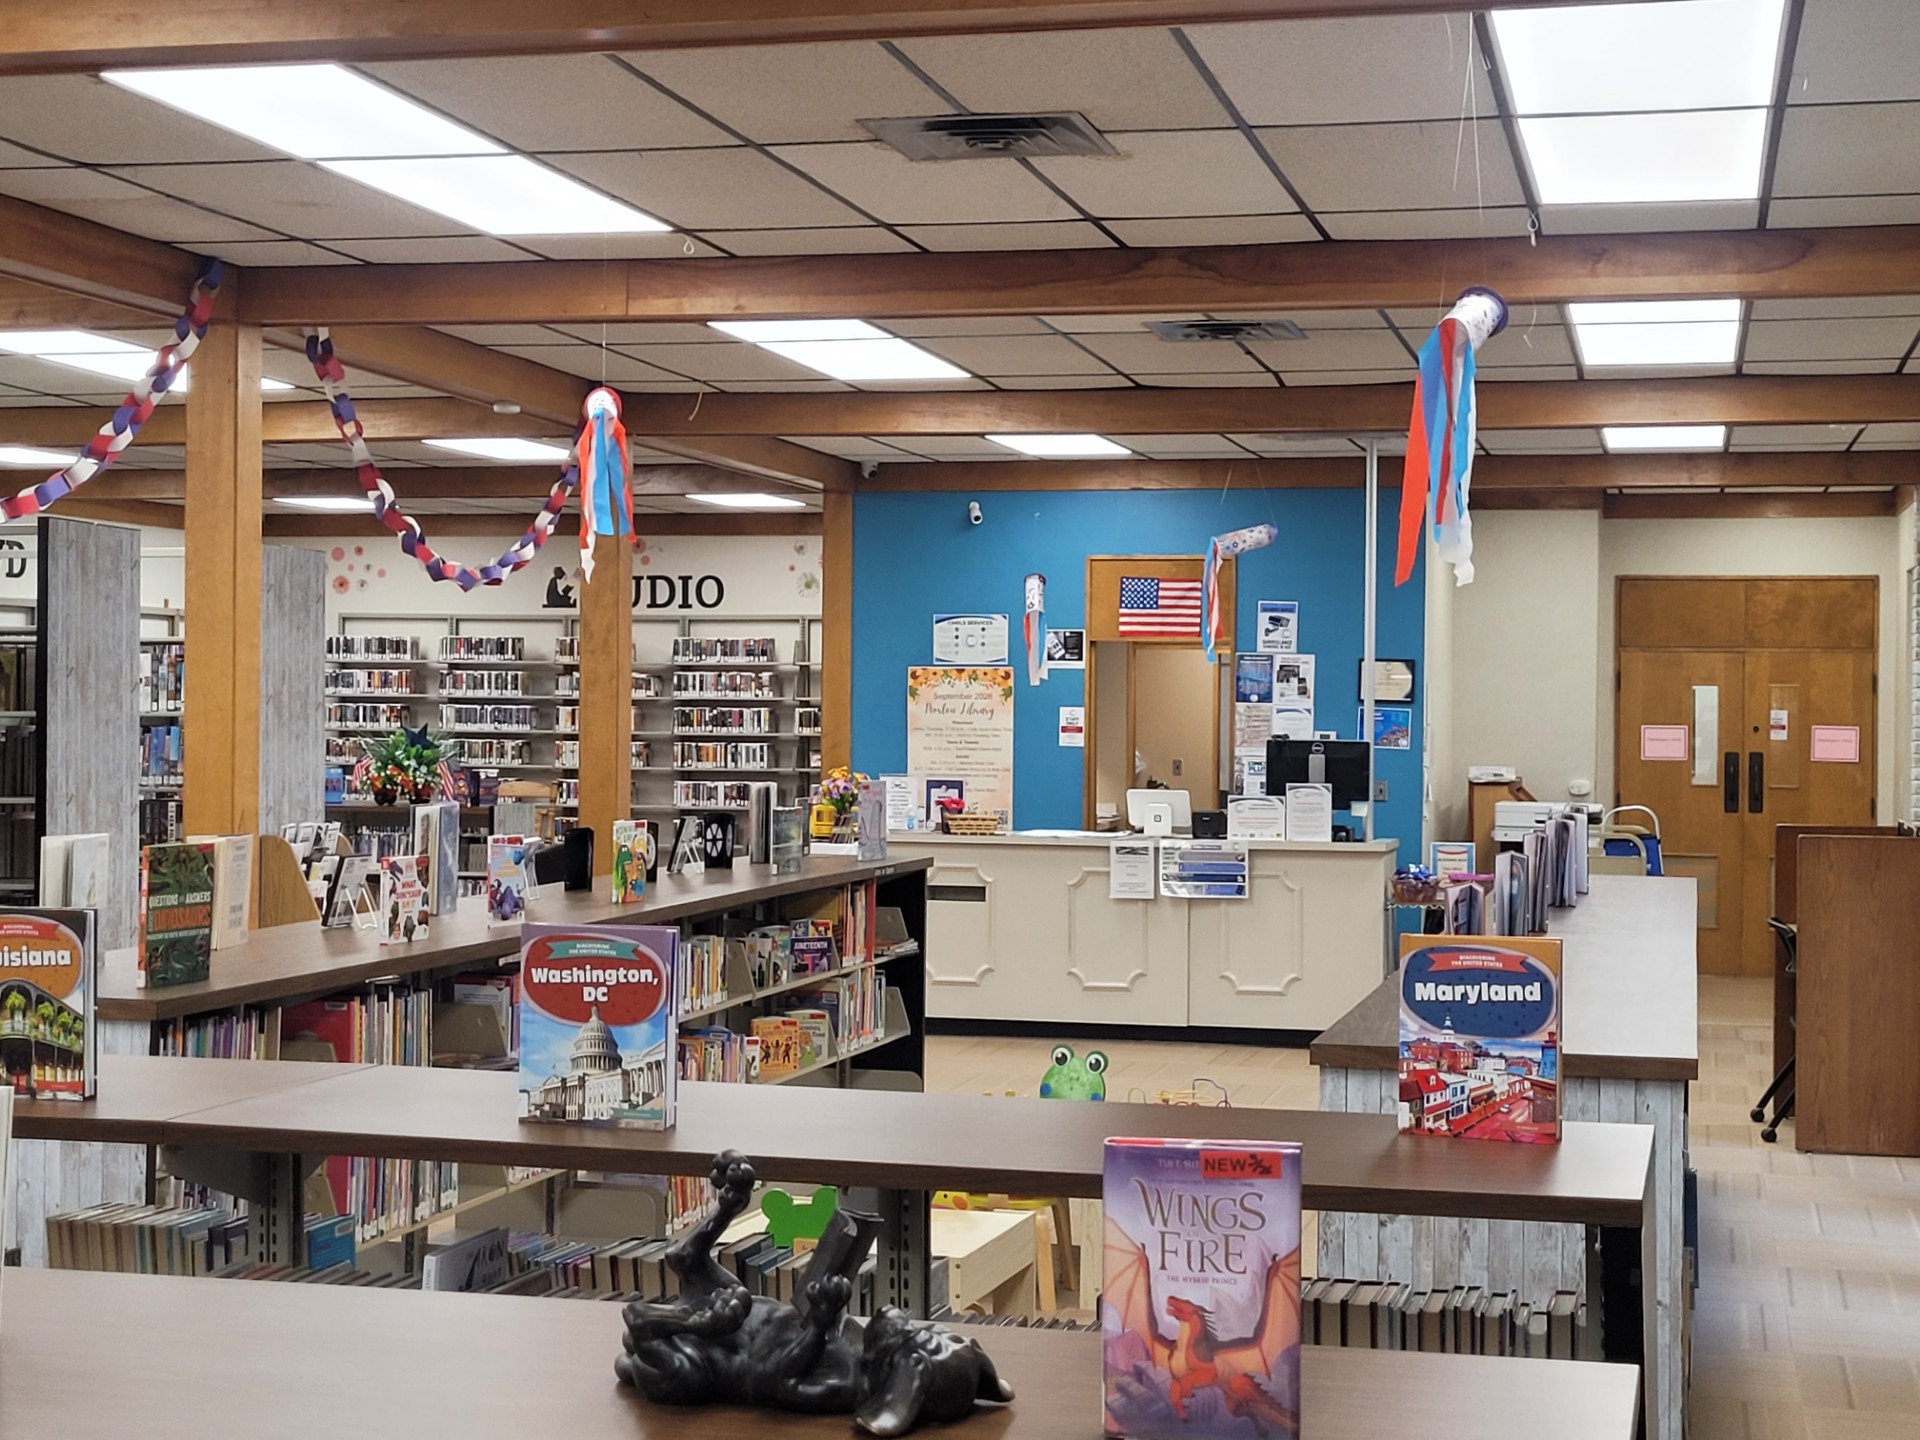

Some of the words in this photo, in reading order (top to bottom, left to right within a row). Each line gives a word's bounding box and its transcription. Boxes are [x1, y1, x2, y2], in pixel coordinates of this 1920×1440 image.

[960, 702, 994, 720] Library
[149, 894, 178, 908] QUESTIONS
[185, 891, 211, 904] ANSWERS
[154, 904, 211, 931] DINOSAURS
[793, 941, 828, 950] JUNETEENTH
[0, 945, 72, 968] isiana
[531, 964, 659, 986] Washington,
[582, 986, 609, 1002] DC
[1414, 981, 1542, 1004] Maryland
[1204, 1158, 1247, 1172] NEW
[1132, 1177, 1267, 1235] WINGS
[1158, 1231, 1248, 1275] FIRE
[1182, 1276, 1209, 1284] HYBRID
[1211, 1277, 1237, 1285] PRINCE
